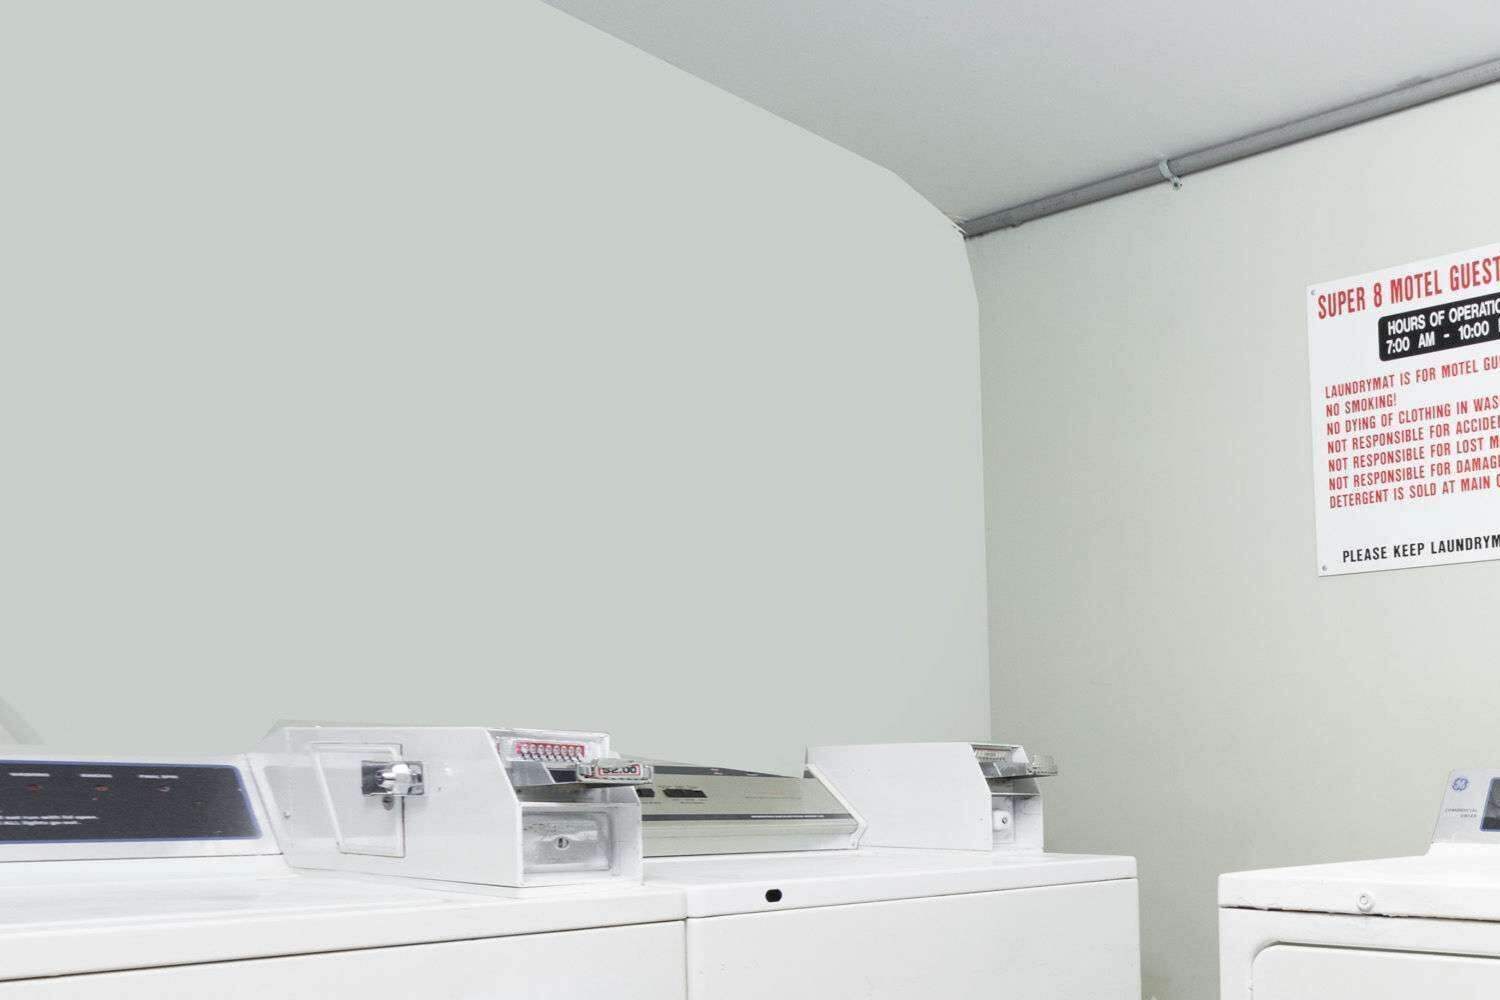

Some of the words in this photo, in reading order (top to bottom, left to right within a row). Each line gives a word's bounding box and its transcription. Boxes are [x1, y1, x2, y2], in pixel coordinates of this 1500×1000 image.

[1318, 287, 1365, 319] SUPER
[1374, 283, 1382, 307] 8
[1391, 270, 1442, 304] MOTEL
[1386, 337, 1410, 354] 7:00
[1419, 332, 1435, 348] AM
[1458, 321, 1489, 341] 10:00
[1388, 313, 1426, 334] HOURS
[1429, 308, 1445, 326] OF
[1325, 375, 1395, 398] LAUNDRYMAT
[1400, 372, 1410, 386] IS
[1416, 366, 1436, 383] FOR
[1442, 360, 1478, 379] MOTEL
[1326, 404, 1339, 416] NO
[1345, 394, 1397, 414] SMOKING!
[1327, 422, 1340, 435] NO
[1345, 416, 1376, 432] DYING
[1381, 413, 1393, 427] OF
[1399, 401, 1451, 424] CLOTHING
[1457, 401, 1468, 414] IN
[1328, 440, 1348, 453] NOT
[1352, 427, 1424, 450] RESPONSIBLE
[1429, 425, 1450, 438] FOR
[1328, 458, 1348, 472] NOT
[1353, 447, 1424, 469] RESPONSIBLE
[1430, 444, 1451, 458] FOR
[1456, 439, 1483, 454] LOST
[1329, 477, 1349, 490] NOT
[1354, 466, 1425, 488] RESPONSIBLE
[1431, 462, 1451, 476] FOR
[1330, 488, 1388, 508] DETERGENT
[1394, 487, 1404, 500] IS
[1410, 482, 1436, 498] SOLD
[1442, 481, 1456, 494] AT
[1460, 475, 1491, 491] MAIN
[1342, 547, 1387, 562] PLEASE
[1393, 542, 1425, 557] KEEP
